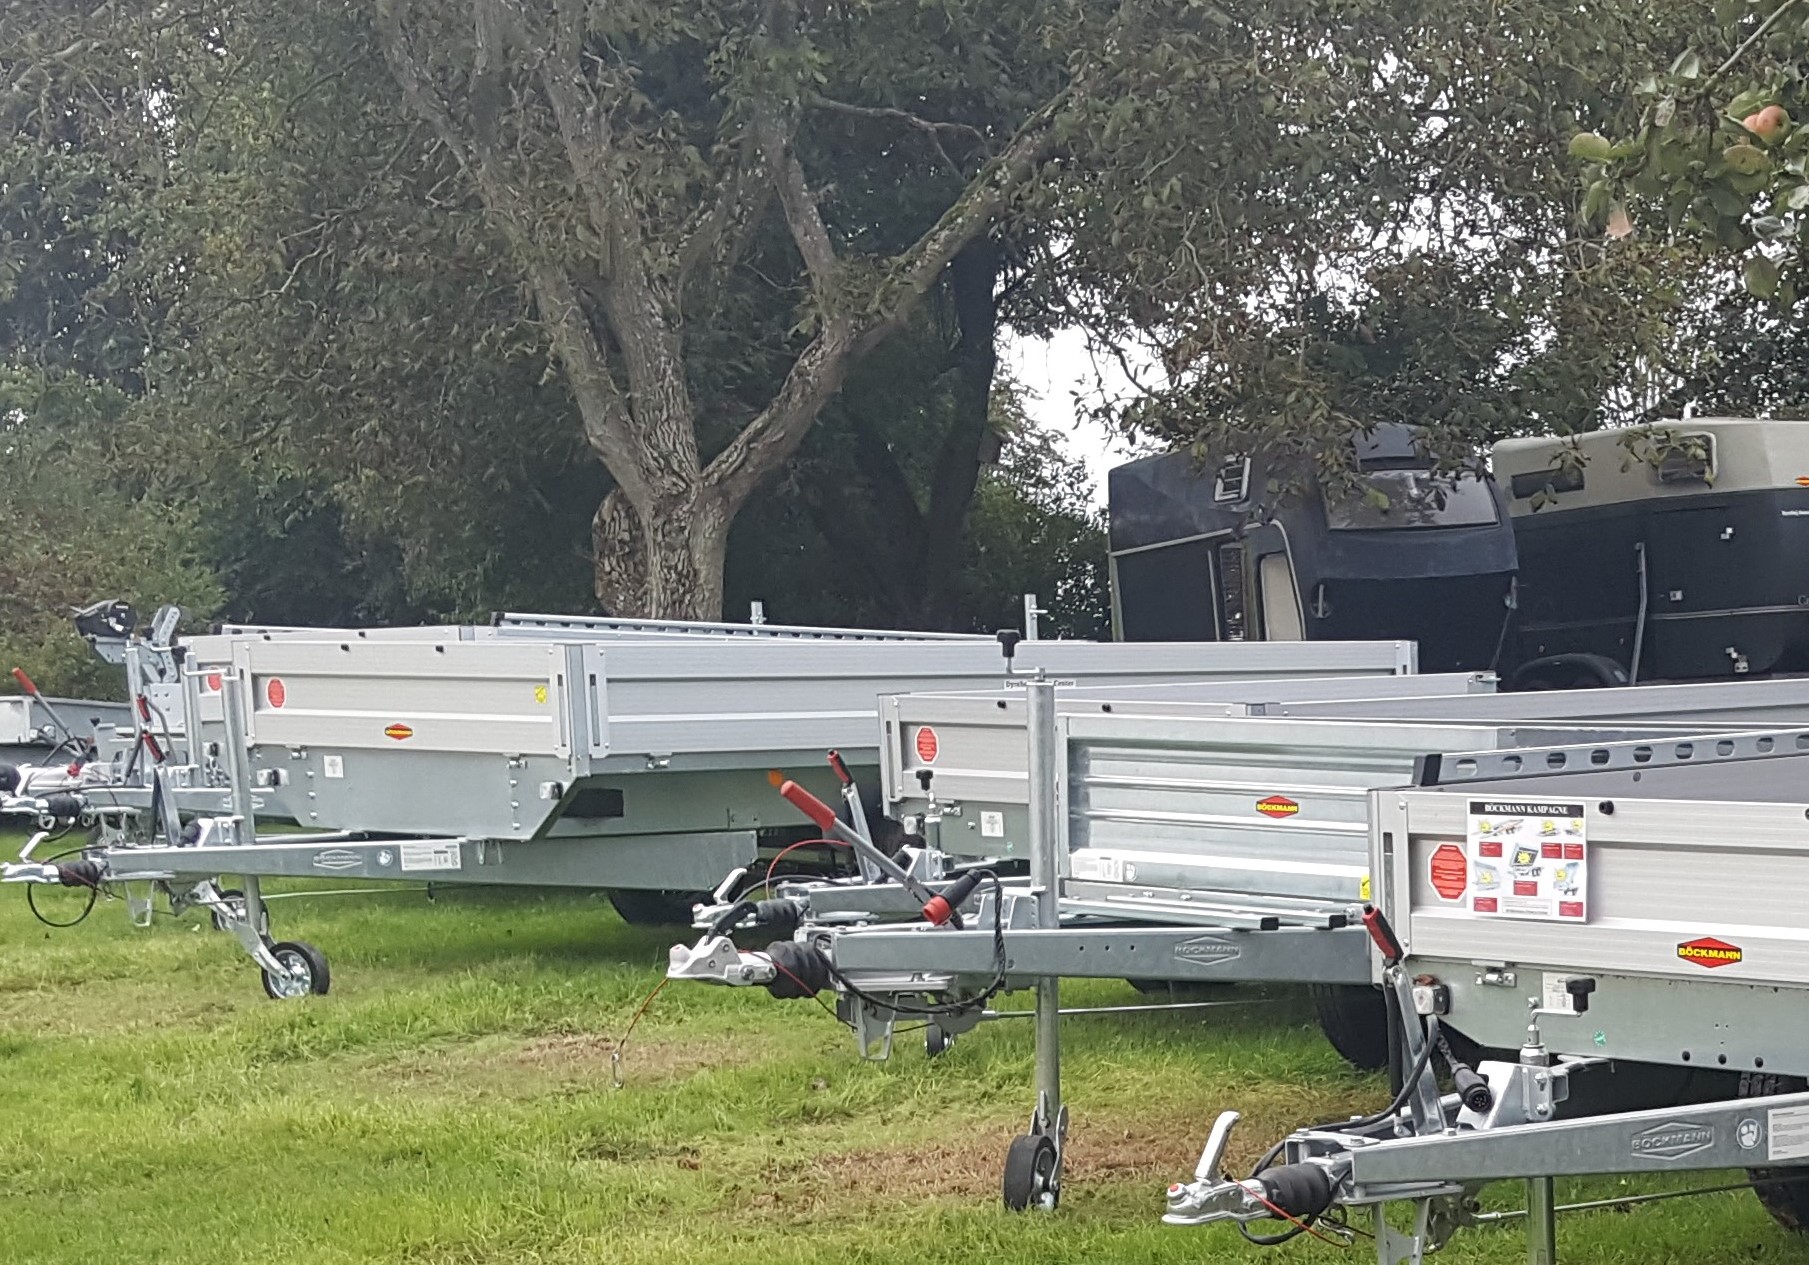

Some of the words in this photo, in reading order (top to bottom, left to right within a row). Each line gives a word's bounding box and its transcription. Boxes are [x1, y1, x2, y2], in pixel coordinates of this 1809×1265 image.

[1484, 803, 1526, 814] BÖCKMANN
[1526, 804, 1569, 815] KAMPAGNE
[1678, 945, 1741, 960] BÖCKMANN
